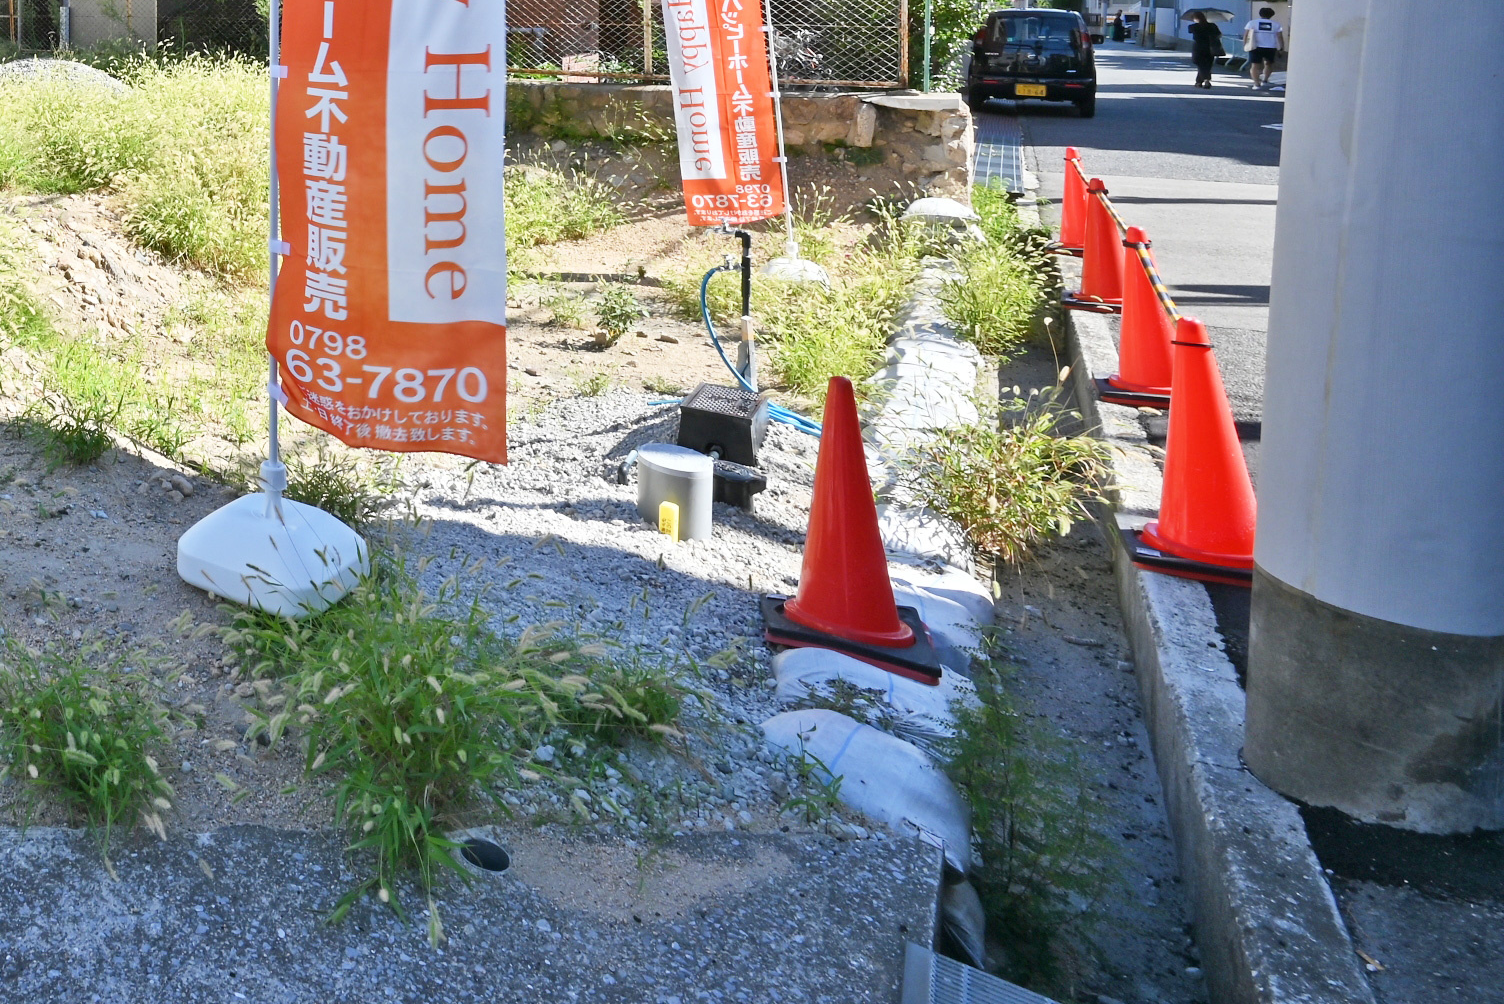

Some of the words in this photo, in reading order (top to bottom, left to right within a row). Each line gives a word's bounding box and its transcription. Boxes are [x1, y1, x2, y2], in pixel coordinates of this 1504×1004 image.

[422, 43, 492, 301] Home
[289, 319, 367, 361] 0798
[285, 348, 489, 404] 63-7870
